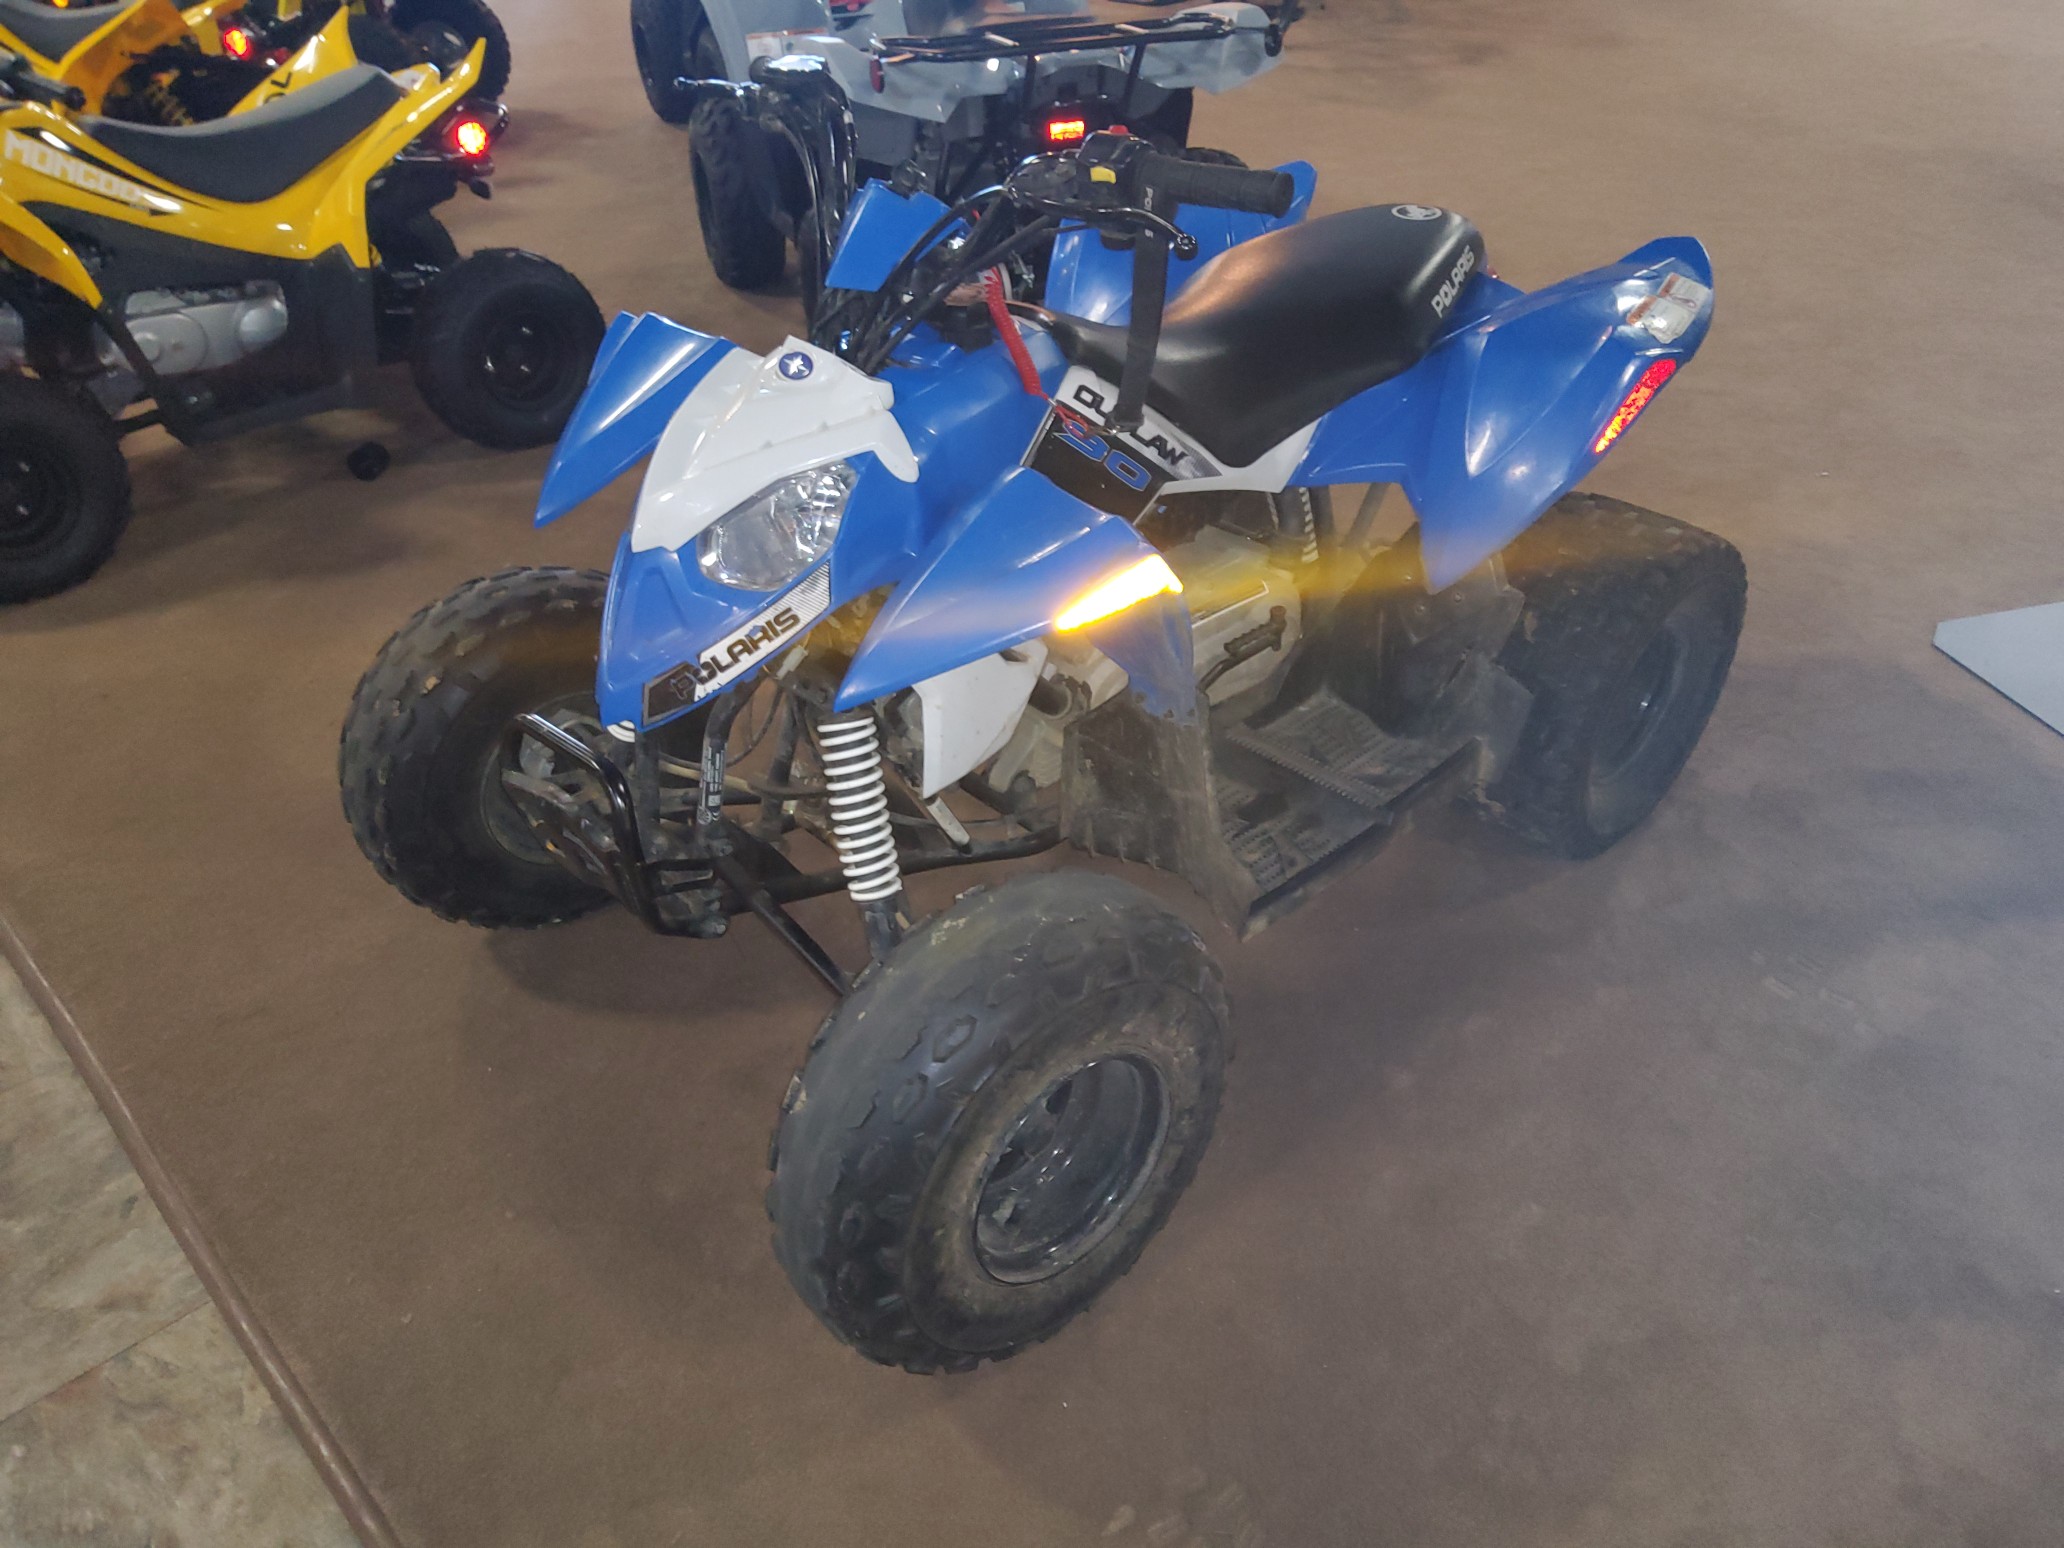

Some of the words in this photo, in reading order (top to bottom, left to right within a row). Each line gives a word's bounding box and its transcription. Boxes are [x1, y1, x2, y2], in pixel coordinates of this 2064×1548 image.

[4, 129, 166, 211] MONGOO
[1430, 244, 1475, 319] POLARIS
[1073, 384, 1189, 466] OULAW
[669, 607, 801, 700] POLARIS
